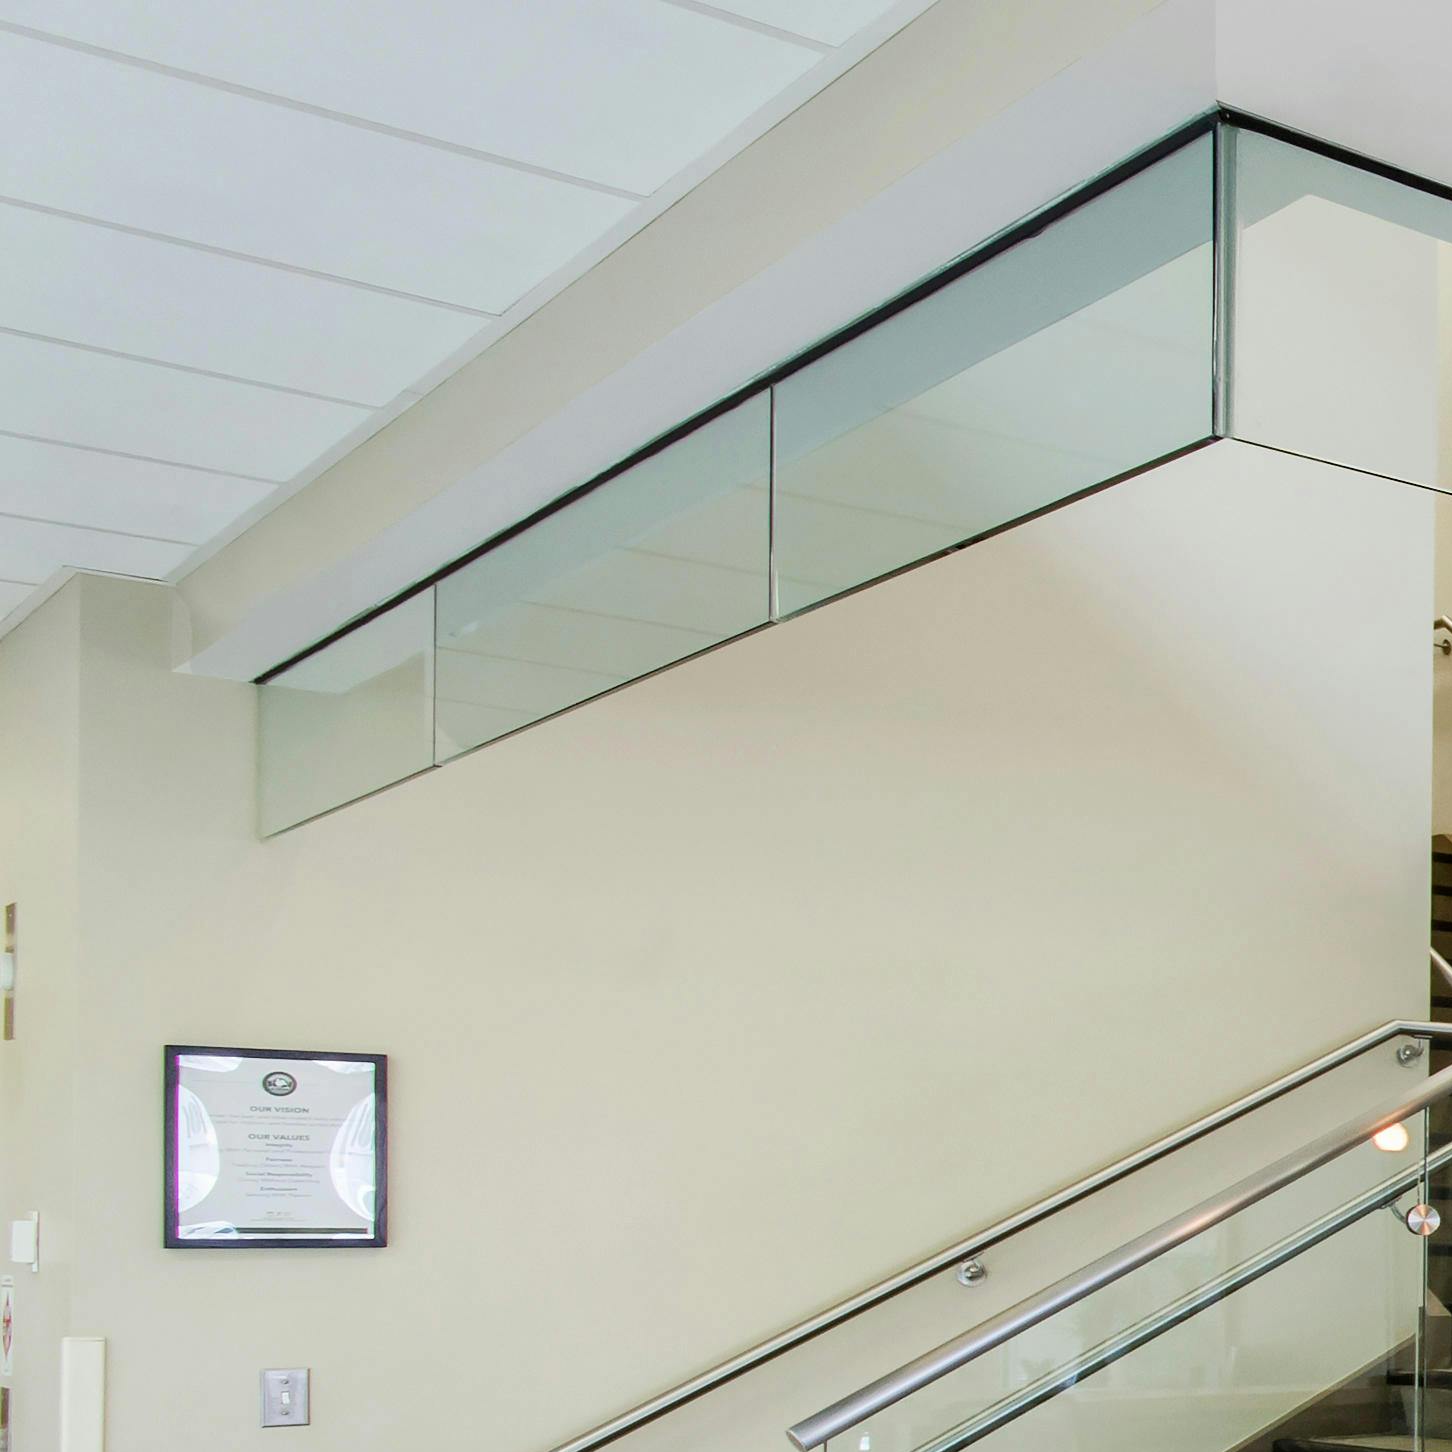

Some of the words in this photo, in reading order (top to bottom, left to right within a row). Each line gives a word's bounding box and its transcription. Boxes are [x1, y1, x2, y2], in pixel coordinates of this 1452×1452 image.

[250, 1105, 271, 1113] OUR
[275, 1106, 309, 1114] VISION
[273, 1134, 310, 1142] VALUES
